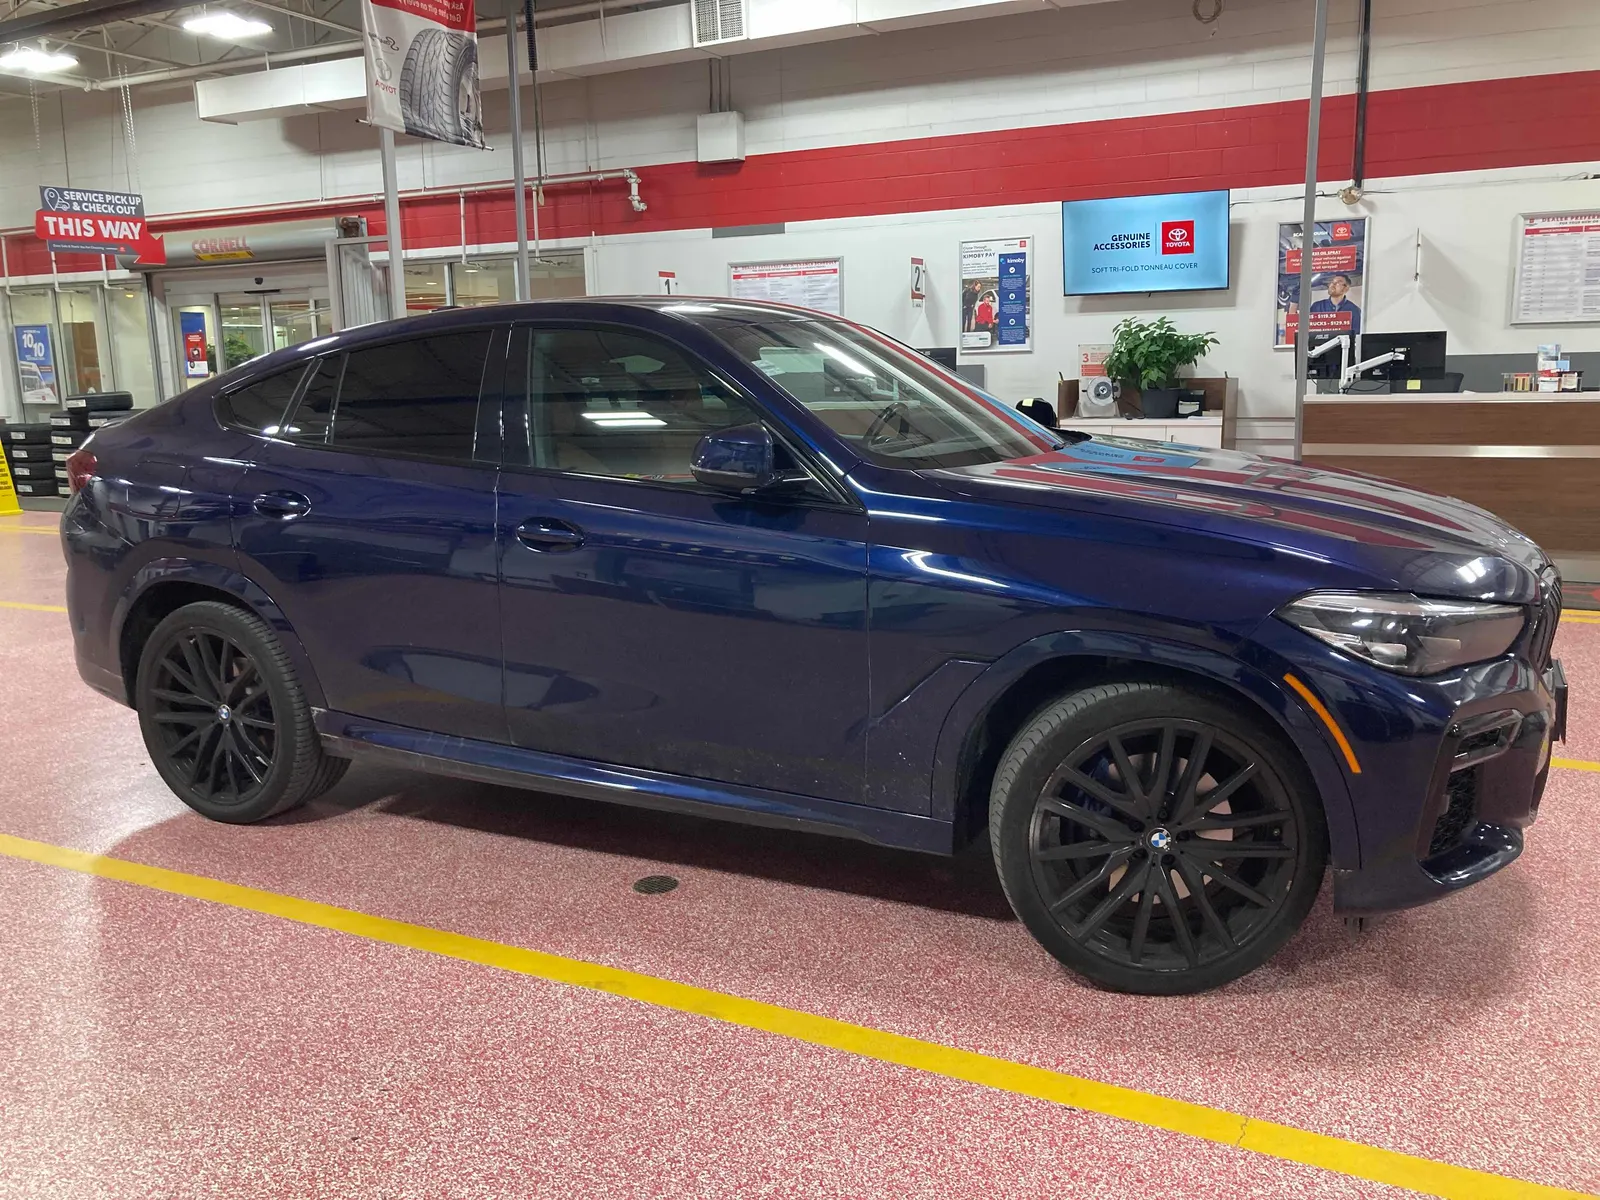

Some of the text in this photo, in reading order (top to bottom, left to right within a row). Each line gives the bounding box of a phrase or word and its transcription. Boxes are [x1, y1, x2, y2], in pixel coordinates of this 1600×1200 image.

[64, 190, 141, 205] SERVICE PICK UP
[72, 201, 136, 215] & CHECK OUT
[43, 216, 142, 240] THIS WAY
[1111, 232, 1150, 242] GENUINE
[191, 236, 251, 254] CORNELL
[1093, 241, 1150, 251] ACCESSORIES
[1091, 266, 1108, 274] SOFT
[1109, 265, 1139, 273] TRI-FOLD
[1140, 263, 1173, 271] TONNEAU
[665, 278, 670, 294] 1
[914, 266, 920, 292] 2
[22, 333, 34, 348] 10
[33, 342, 44, 357] 10
[1082, 353, 1089, 362] 3
